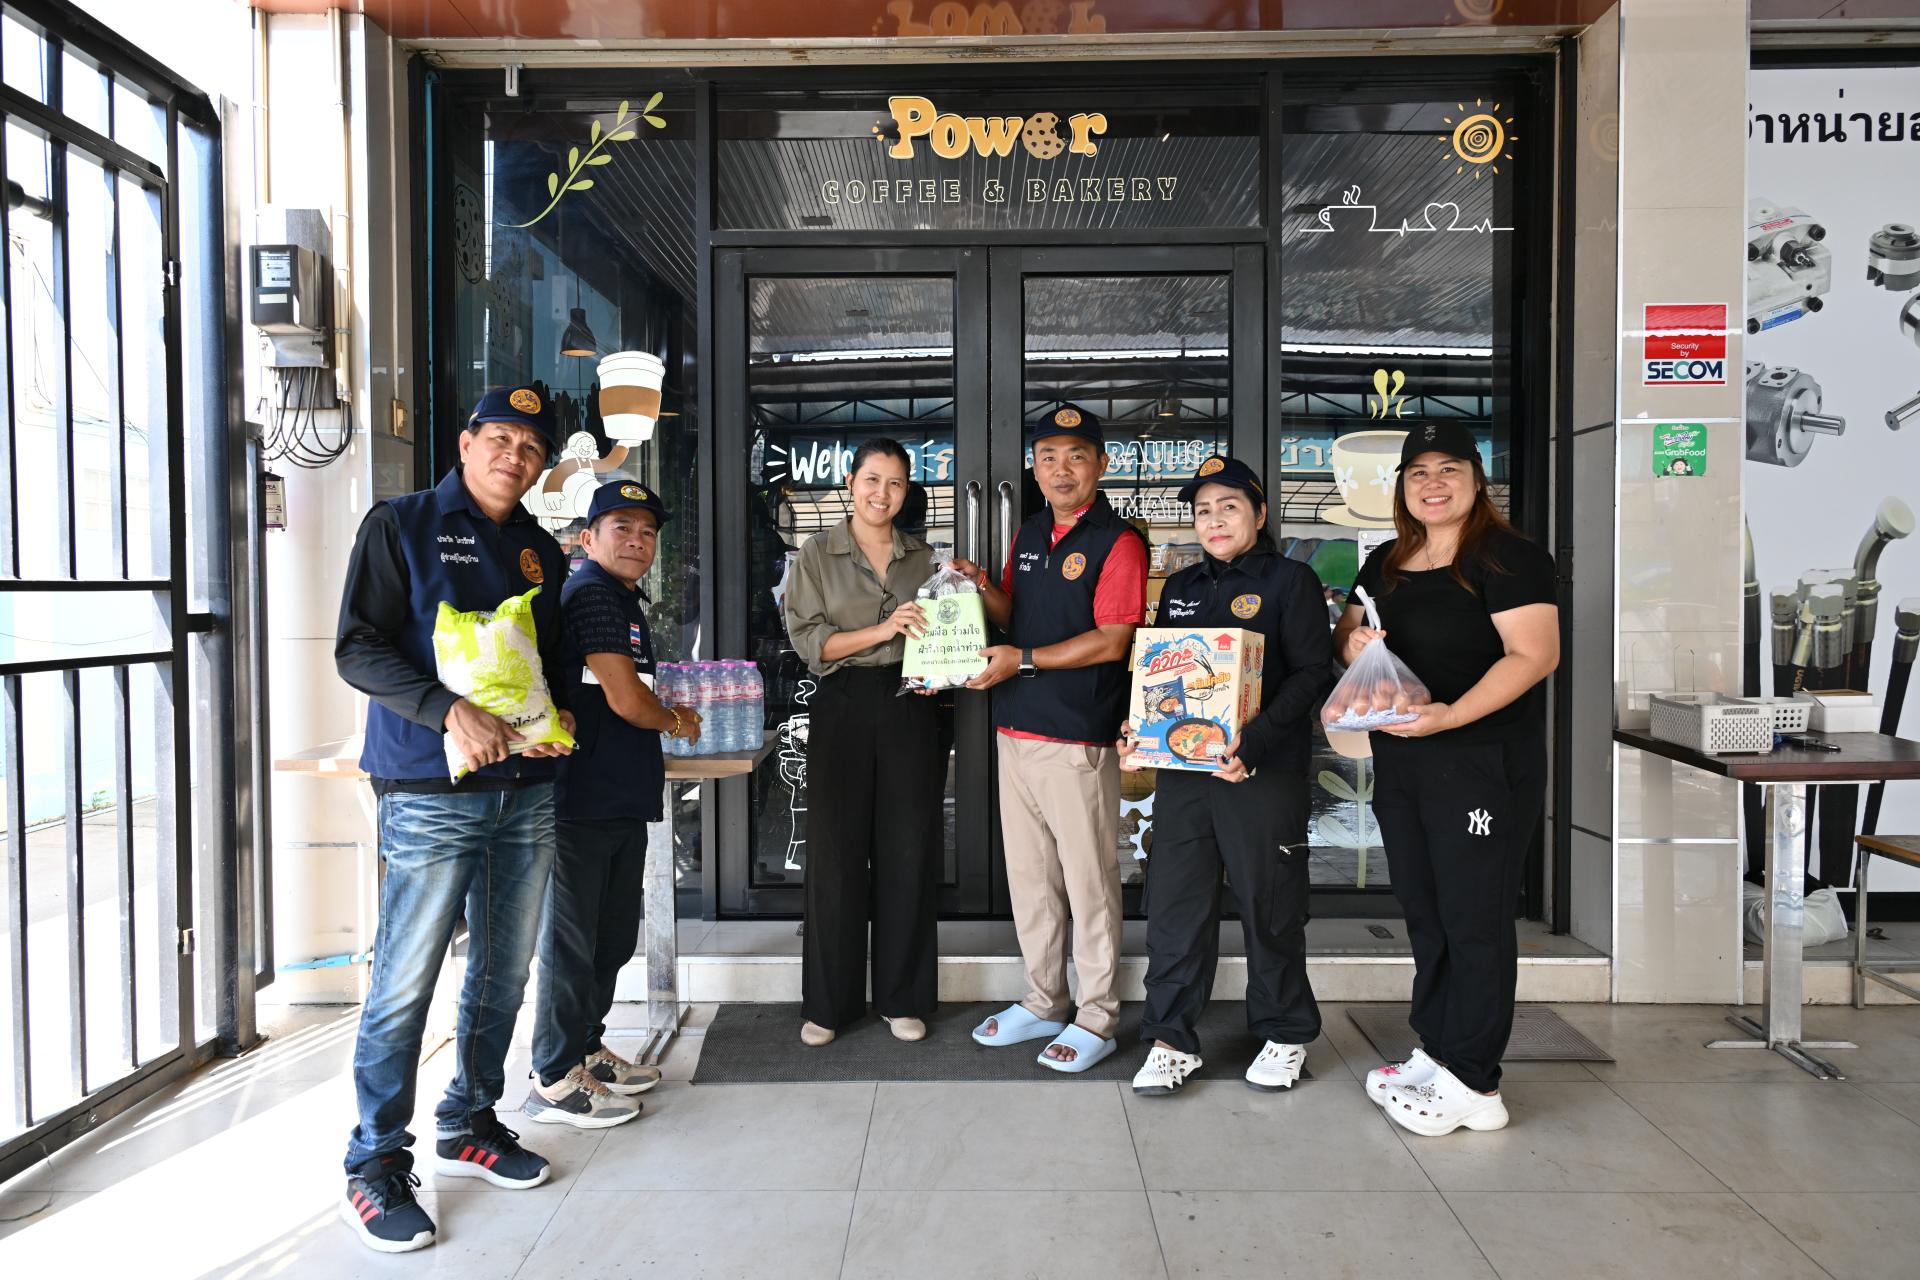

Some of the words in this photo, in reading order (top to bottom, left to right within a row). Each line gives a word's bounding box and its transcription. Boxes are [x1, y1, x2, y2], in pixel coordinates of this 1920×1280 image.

[1749, 88, 1920, 143] ำหน่าย
[822, 179, 961, 203] COFFEE
[983, 178, 1004, 202] &
[1027, 177, 1178, 202] BAKERY
[1671, 342, 1699, 351] Security
[1647, 360, 1723, 380] SECOM
